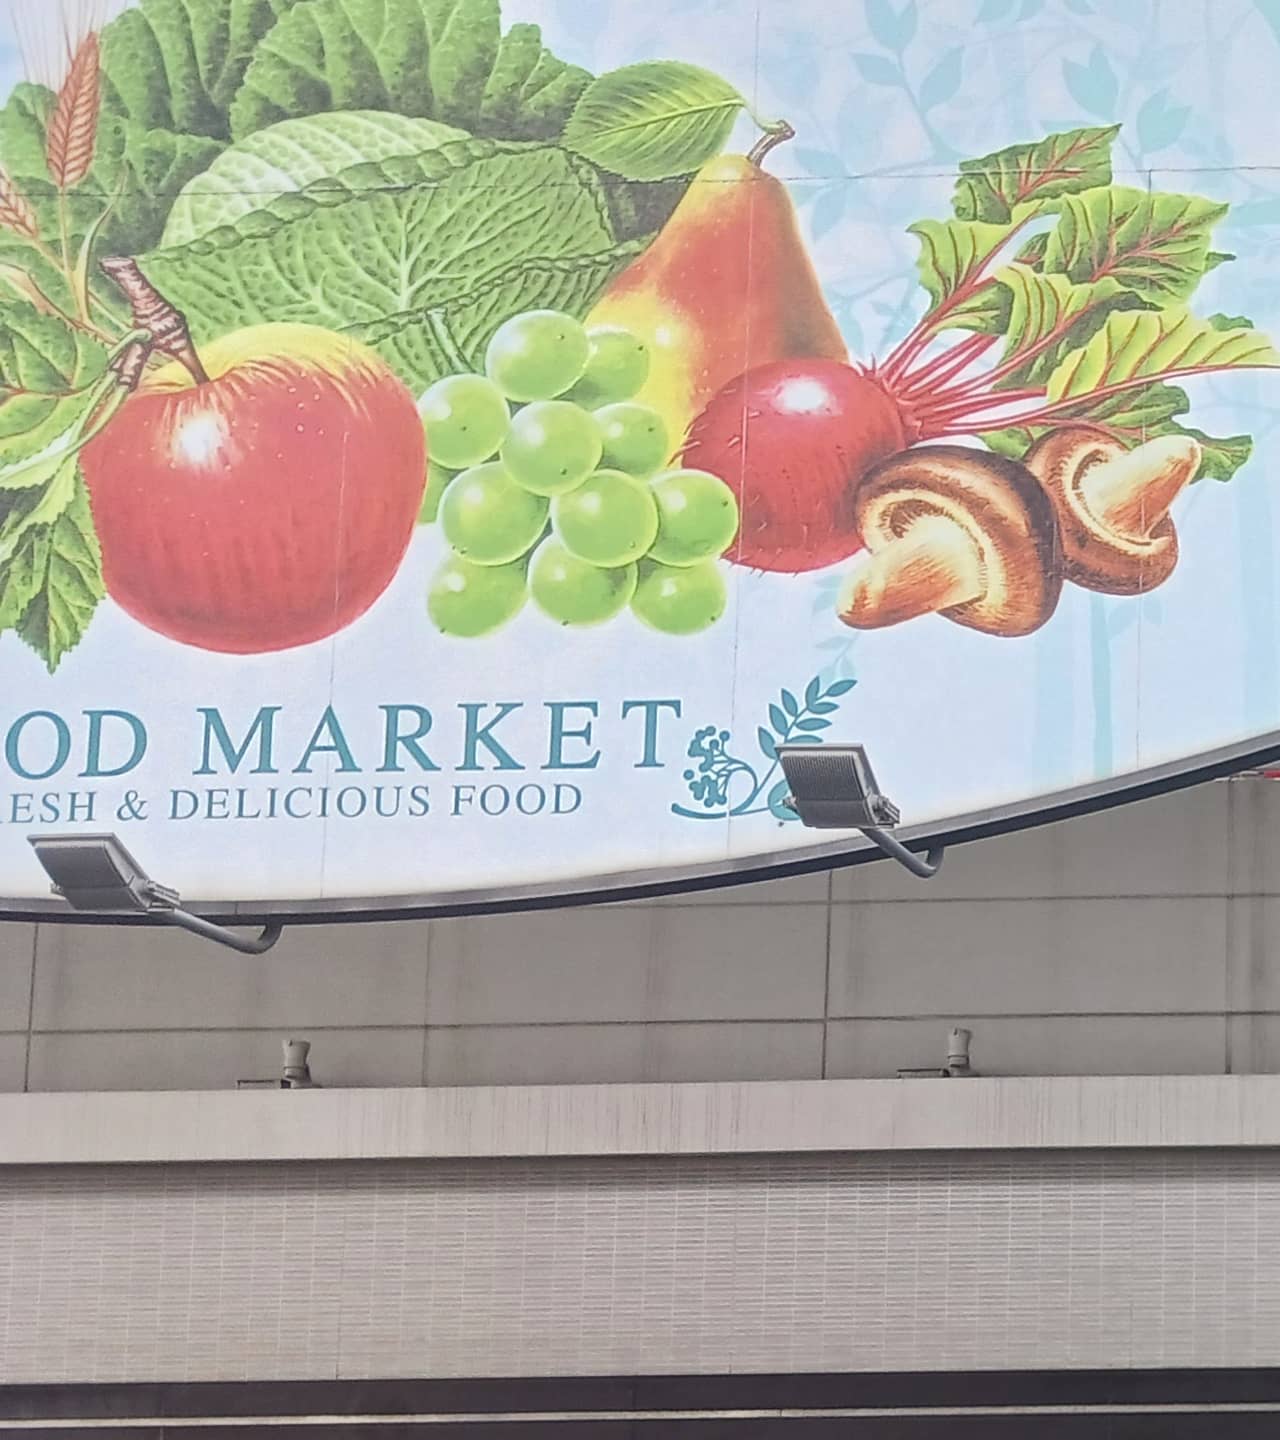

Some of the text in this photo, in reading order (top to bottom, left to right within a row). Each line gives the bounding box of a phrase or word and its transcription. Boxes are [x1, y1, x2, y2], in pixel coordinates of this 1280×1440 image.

[193, 699, 683, 775] MARKET
[0, 781, 583, 824] ESH & DELICIOUS FOOD
